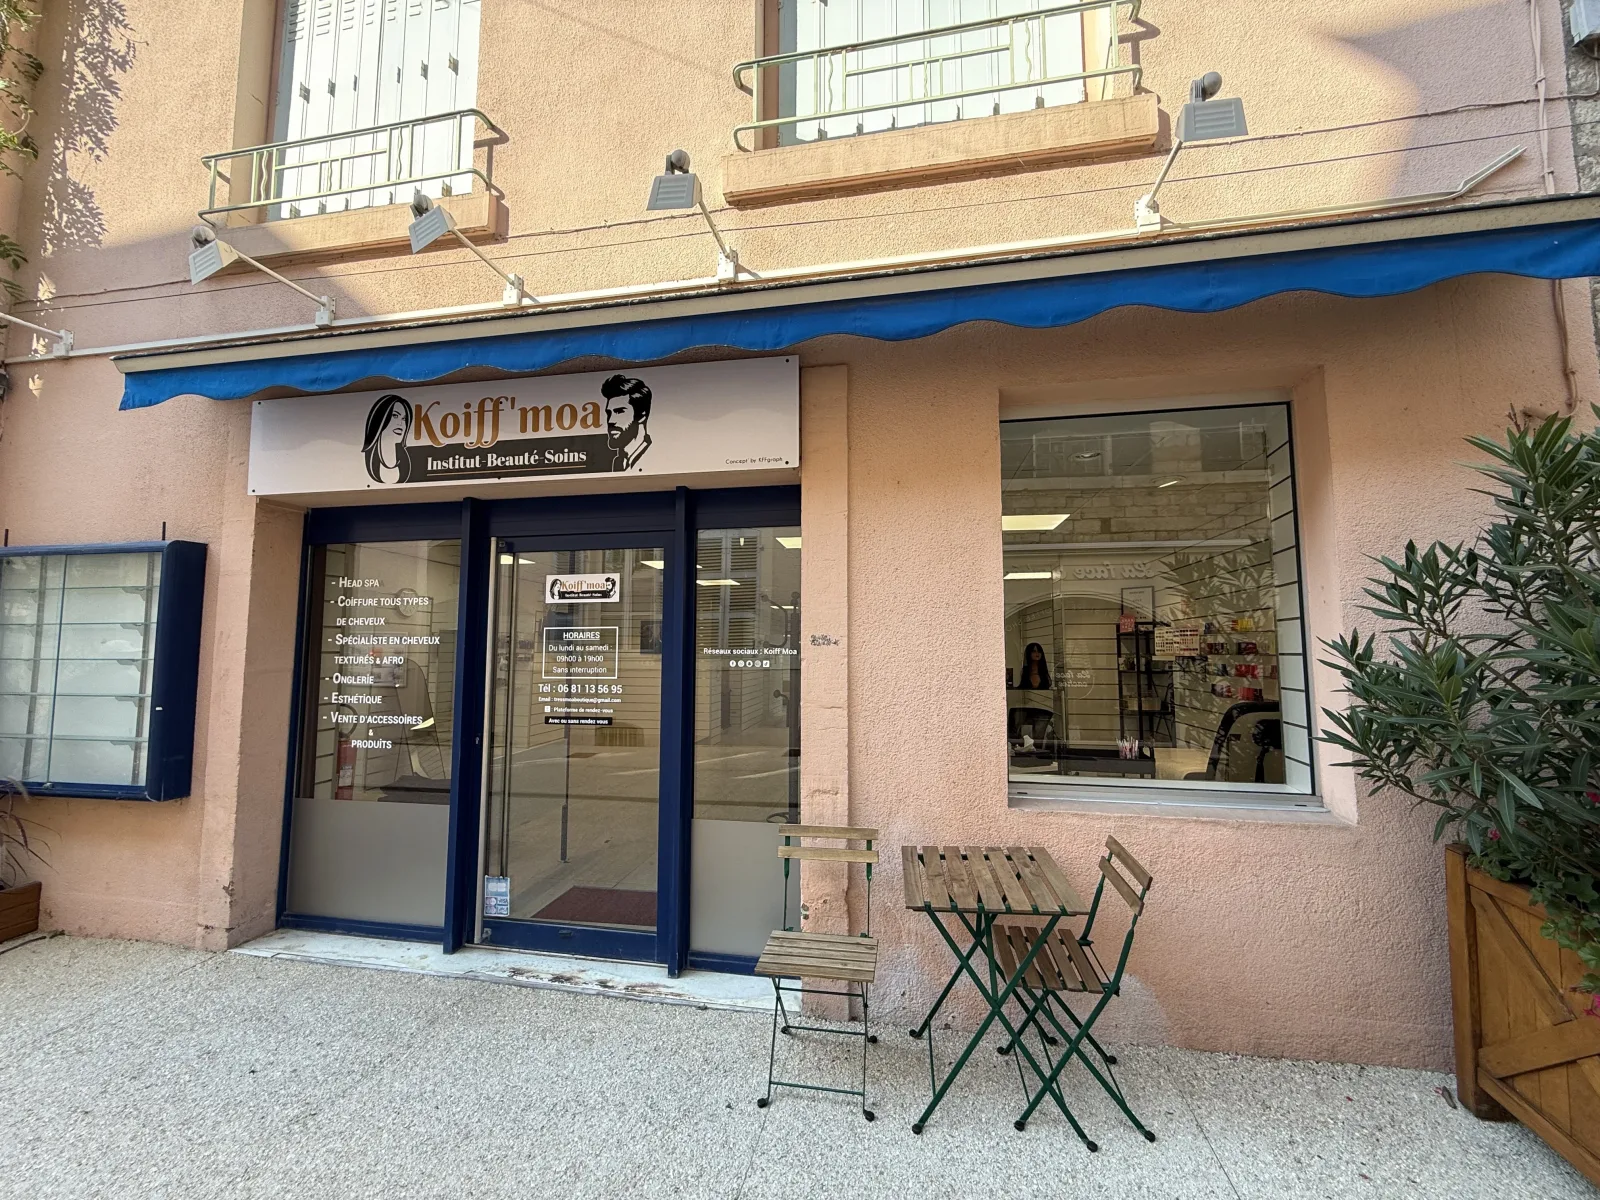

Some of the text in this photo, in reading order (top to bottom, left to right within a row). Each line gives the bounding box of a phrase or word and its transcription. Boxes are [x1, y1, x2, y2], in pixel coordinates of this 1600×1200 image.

[413, 396, 602, 448] Koiff'moa
[365, 579, 379, 587] SPA
[562, 580, 605, 592] Koiff'moa
[380, 598, 401, 606] TOUS
[403, 597, 429, 606] TYPES
[336, 617, 385, 626] DE CHEVEUX
[402, 636, 440, 645] CHEVEUX
[563, 632, 600, 640] HORAIRES
[704, 647, 731, 655] Réseaux
[334, 654, 374, 665] TEXTURÉS
[382, 656, 404, 664] AFRO
[538, 684, 550, 693] Tél
[558, 684, 569, 693] 06
[571, 684, 581, 693] 81
[585, 684, 596, 693] 13
[598, 685, 609, 693] 56
[611, 685, 622, 693] 95
[331, 712, 358, 723] VENTE
